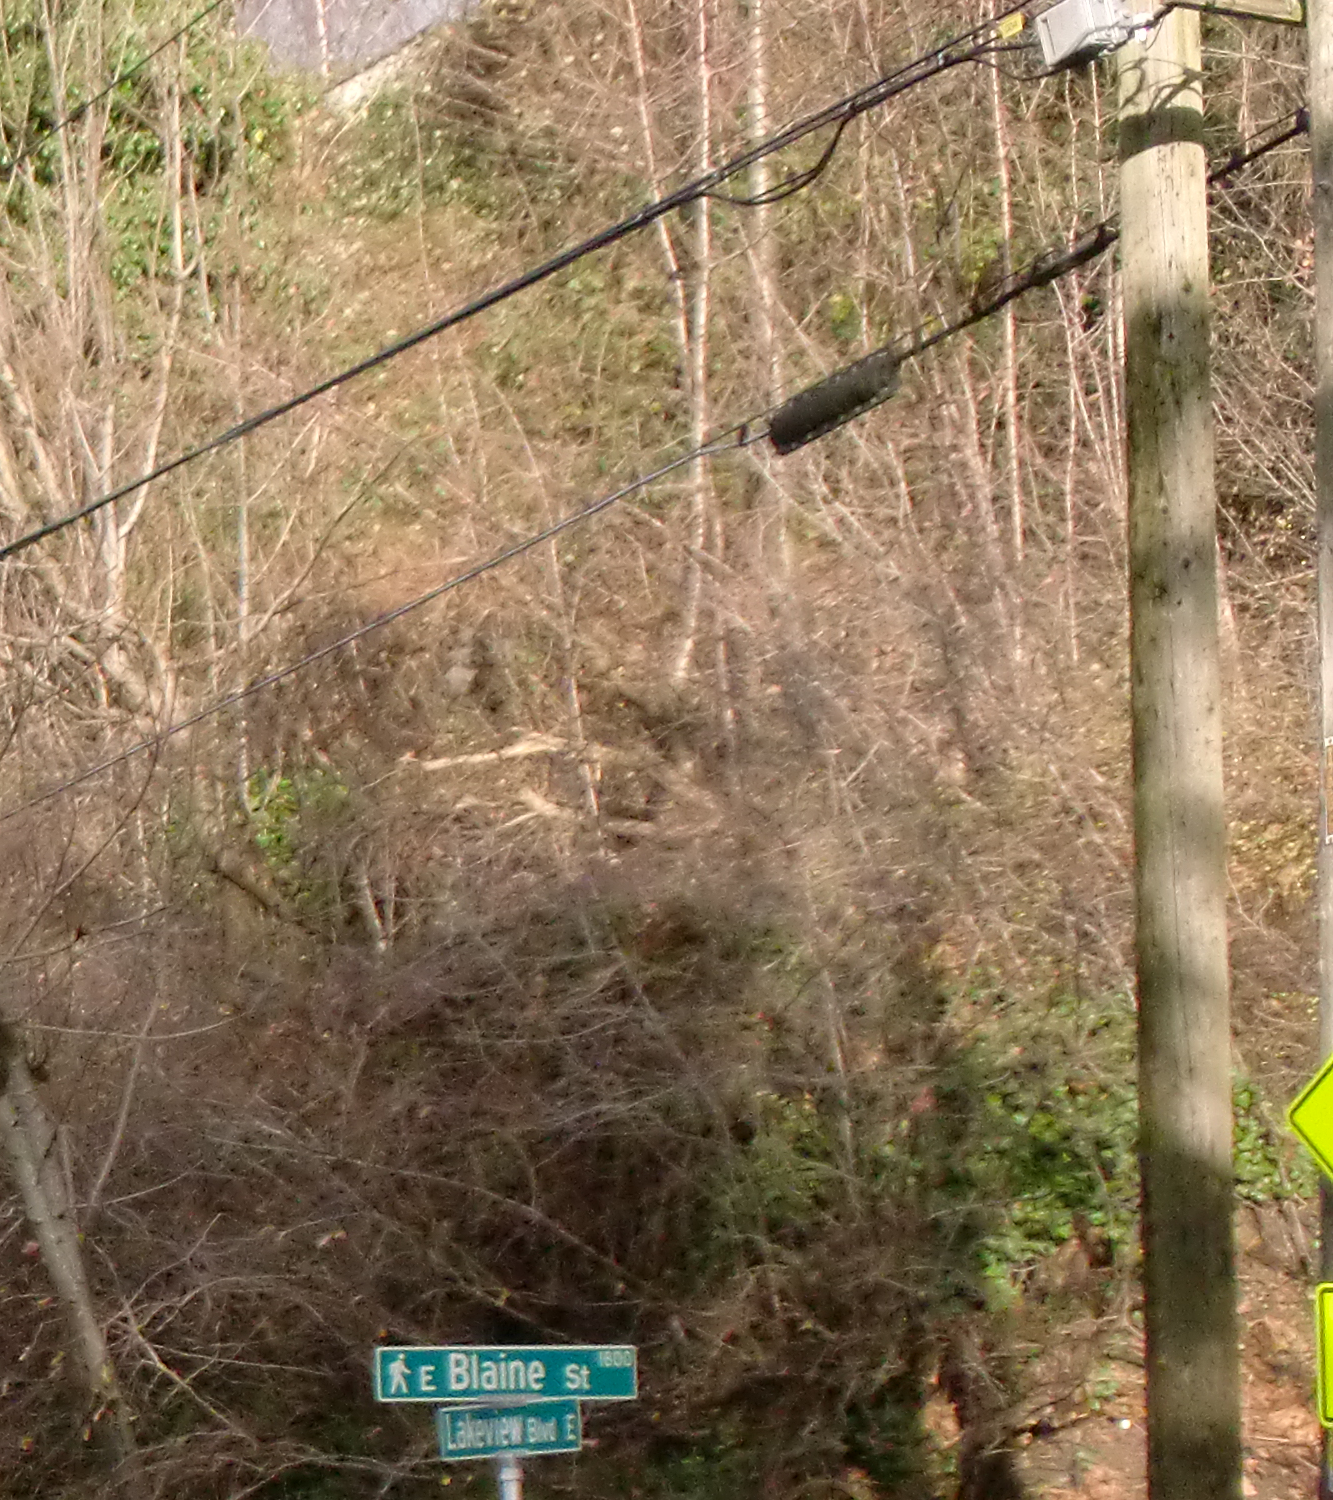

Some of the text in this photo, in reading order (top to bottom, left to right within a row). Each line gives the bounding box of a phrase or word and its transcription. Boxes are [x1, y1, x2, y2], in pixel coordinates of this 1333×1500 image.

[420, 1352, 591, 1391] E Blaine St
[565, 1413, 577, 1441] E
